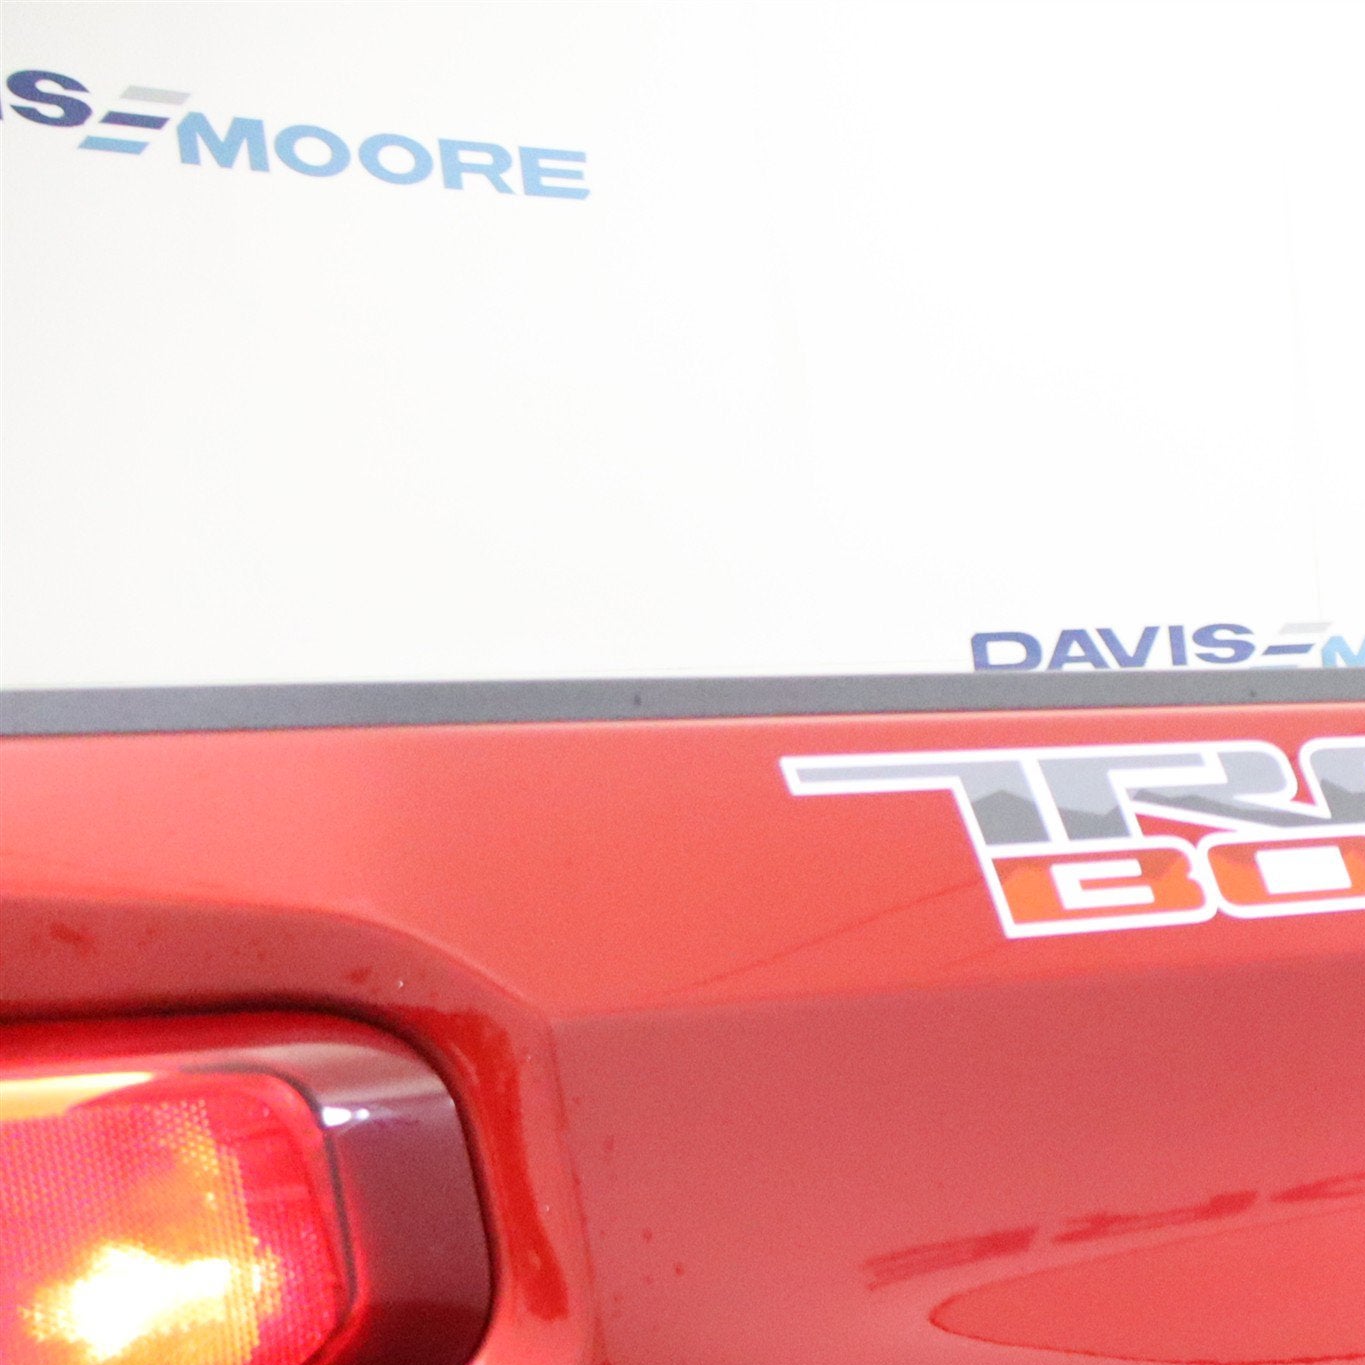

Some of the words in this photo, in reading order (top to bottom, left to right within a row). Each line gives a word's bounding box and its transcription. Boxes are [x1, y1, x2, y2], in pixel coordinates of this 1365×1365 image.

[0, 68, 94, 128] S
[177, 111, 590, 200] MOORE
[970, 622, 1256, 671] DAVIS
